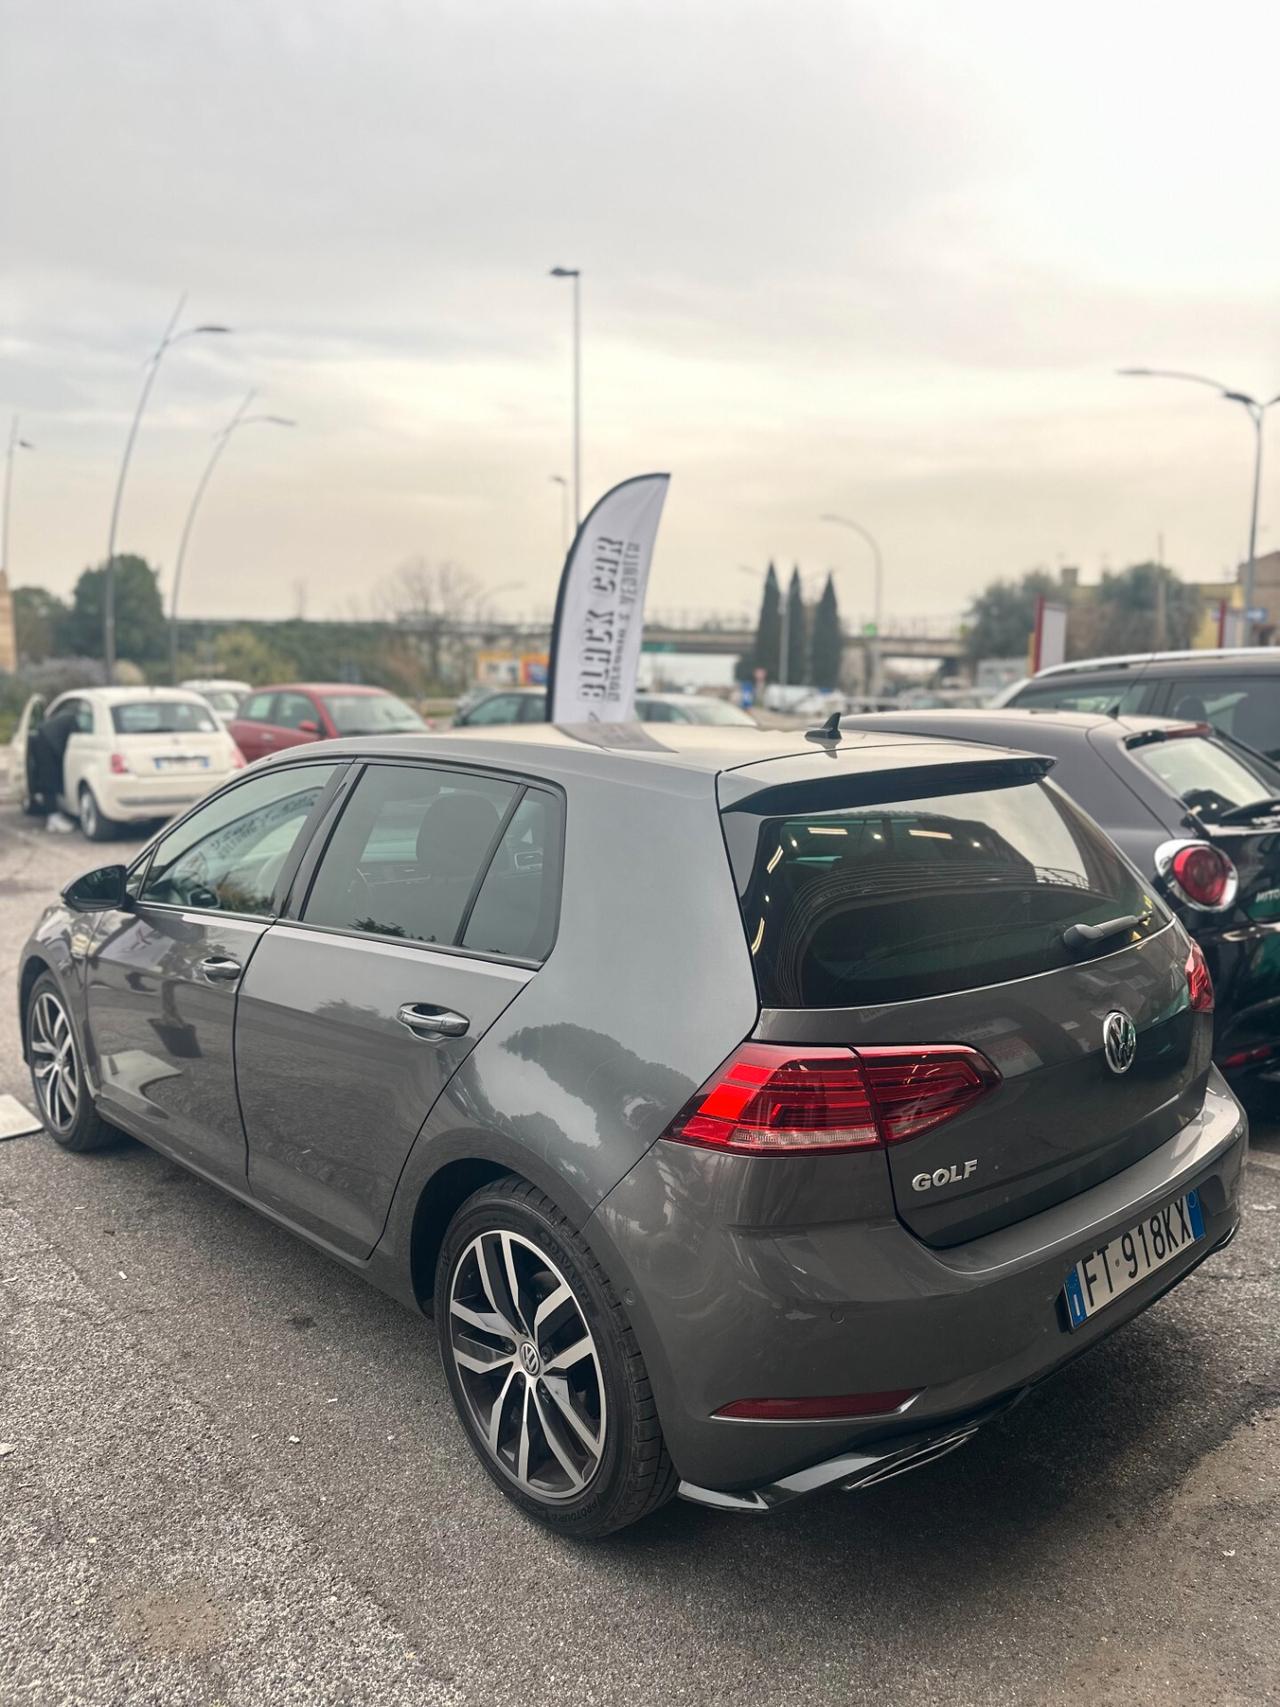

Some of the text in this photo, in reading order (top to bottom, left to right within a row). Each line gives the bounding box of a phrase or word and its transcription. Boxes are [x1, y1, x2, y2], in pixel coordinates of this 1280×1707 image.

[579, 536, 625, 702] BLACK CAR
[911, 1159, 978, 1192] GOLF
